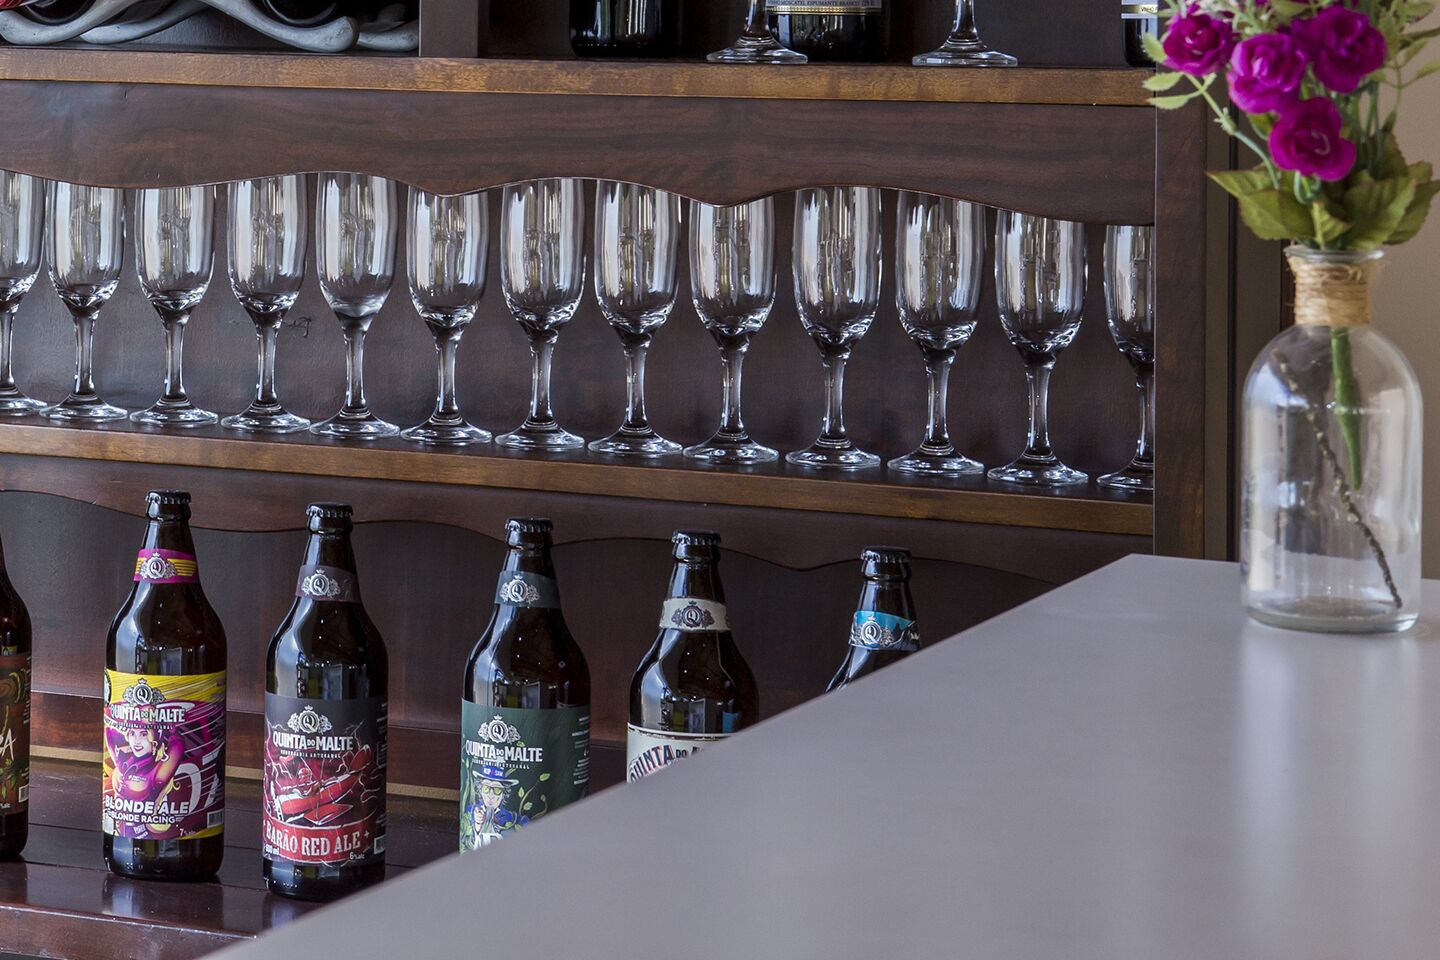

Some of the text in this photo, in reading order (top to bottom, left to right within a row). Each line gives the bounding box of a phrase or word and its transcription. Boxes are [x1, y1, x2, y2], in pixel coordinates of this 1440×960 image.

[110, 704, 186, 723] QUINTA DO MALTE
[273, 731, 354, 751] QUINTA DO MALTE
[465, 740, 543, 762] QUINTA DO MALTE
[675, 749, 687, 759] DO
[105, 795, 190, 815] BLONDE ALE
[110, 812, 176, 824] BLONDE RACING
[266, 820, 361, 856] BARÃO RED ALE
